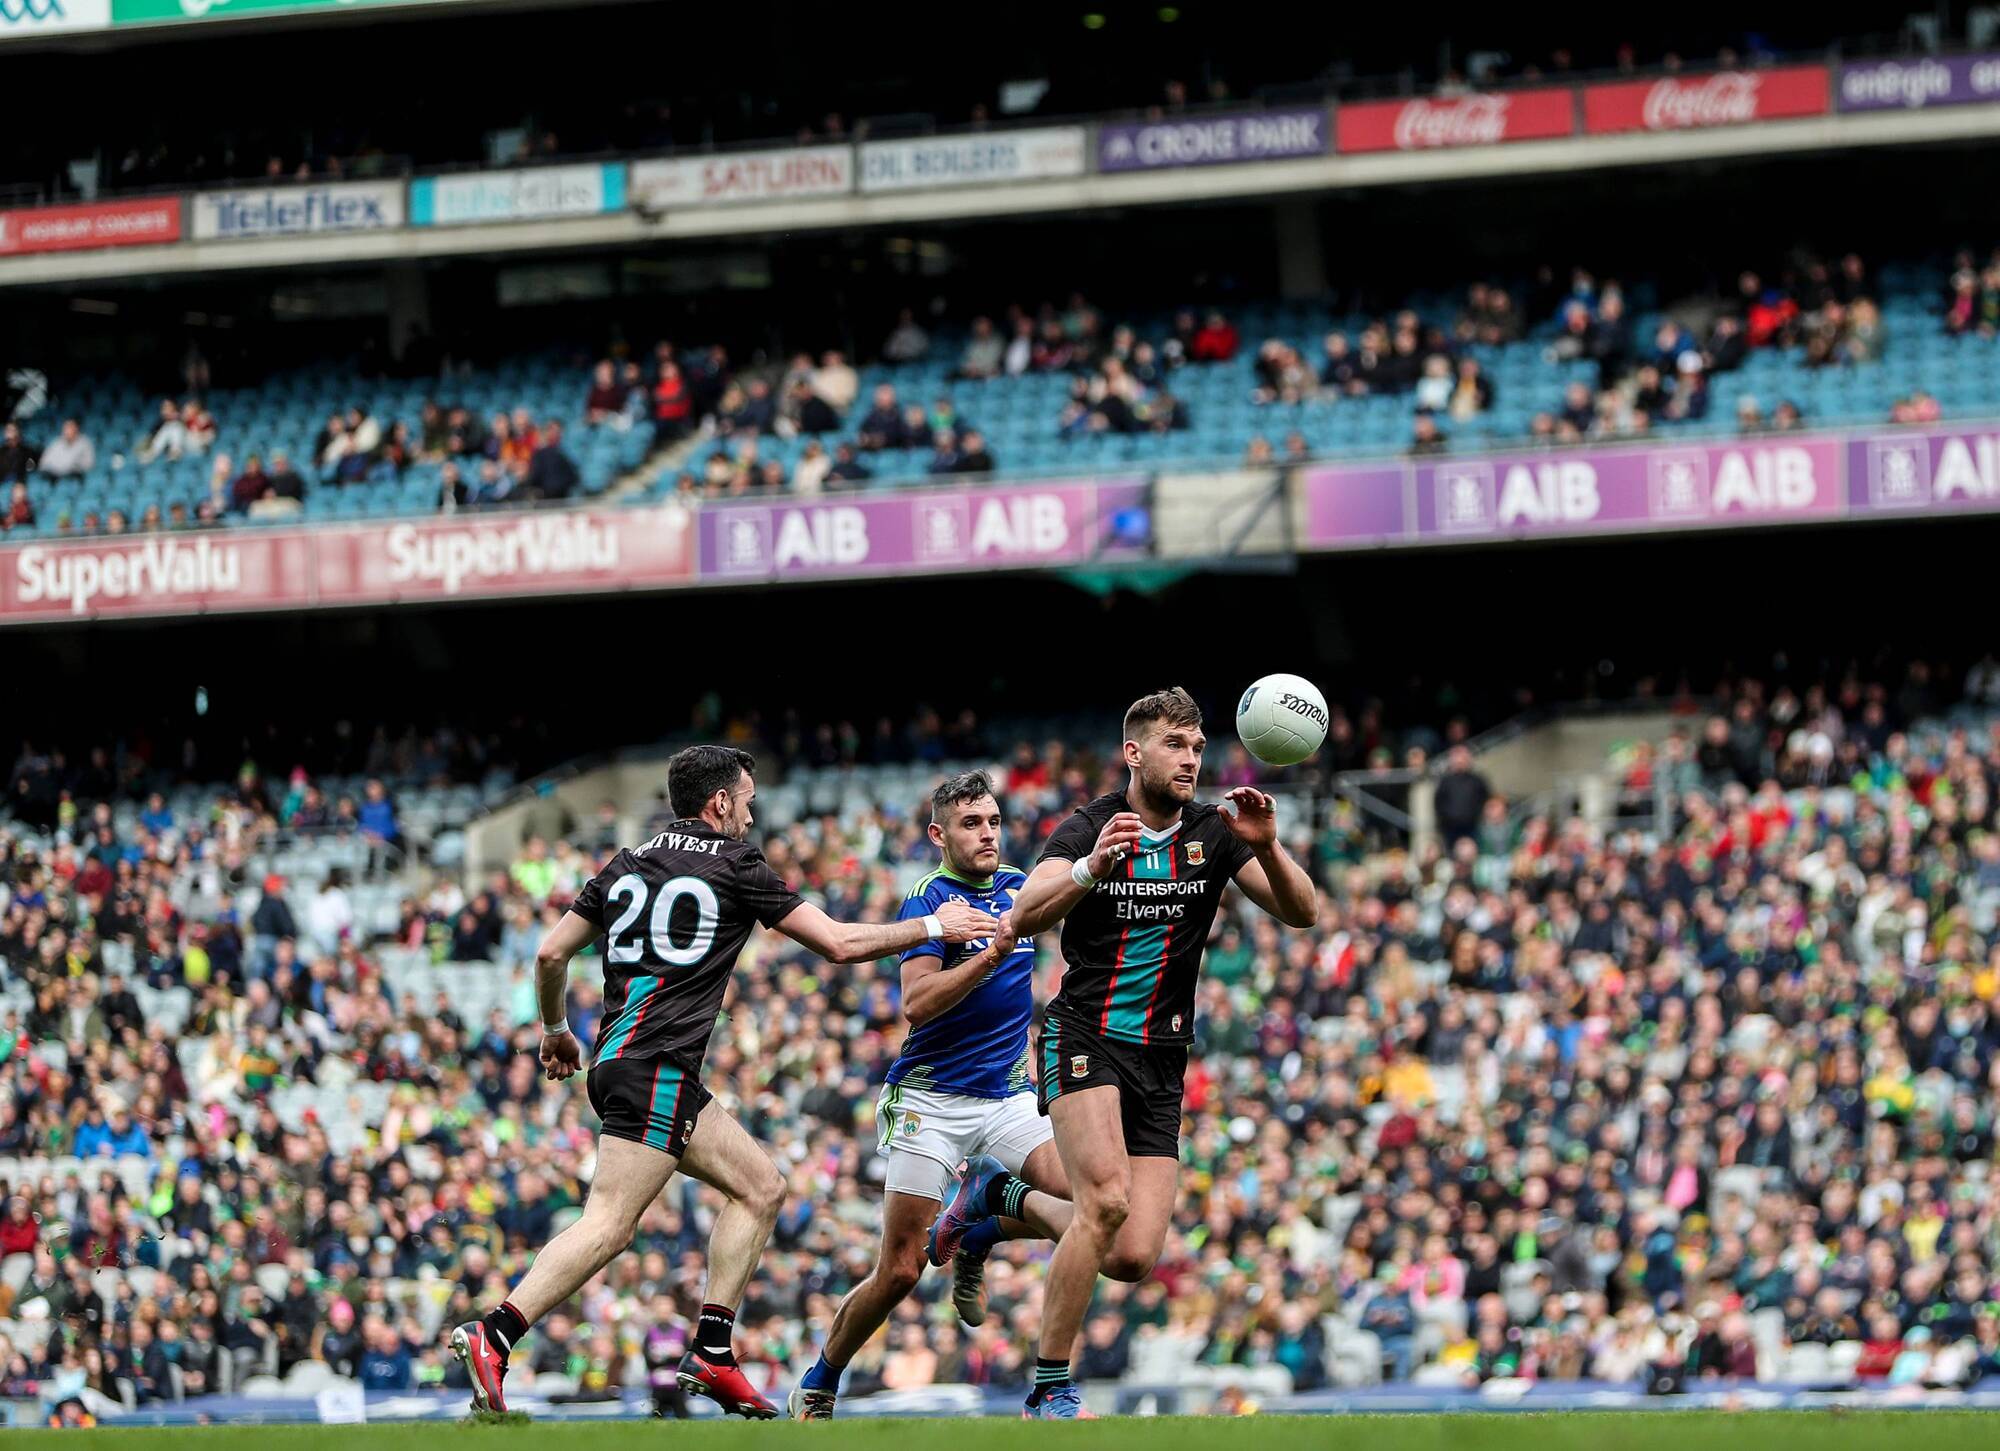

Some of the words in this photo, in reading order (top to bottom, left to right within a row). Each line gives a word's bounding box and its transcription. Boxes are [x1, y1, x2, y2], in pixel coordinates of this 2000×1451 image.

[1842, 58, 1951, 107] energia
[1135, 119, 1235, 165] CROKE
[1241, 112, 1320, 155] PARK
[701, 154, 845, 195] SATURN
[210, 189, 384, 236] Teleflex
[1498, 460, 1600, 527] AIB
[1711, 447, 1816, 513] AIB
[387, 511, 619, 594] SuperValu
[774, 506, 870, 566] AIB
[972, 495, 1068, 554] AIB
[17, 535, 240, 615] SuperValu
[1109, 880, 1207, 896] INTERSPORT
[1146, 851, 1160, 870] 11
[606, 871, 720, 966] 20
[1116, 899, 1185, 921] Elverys
